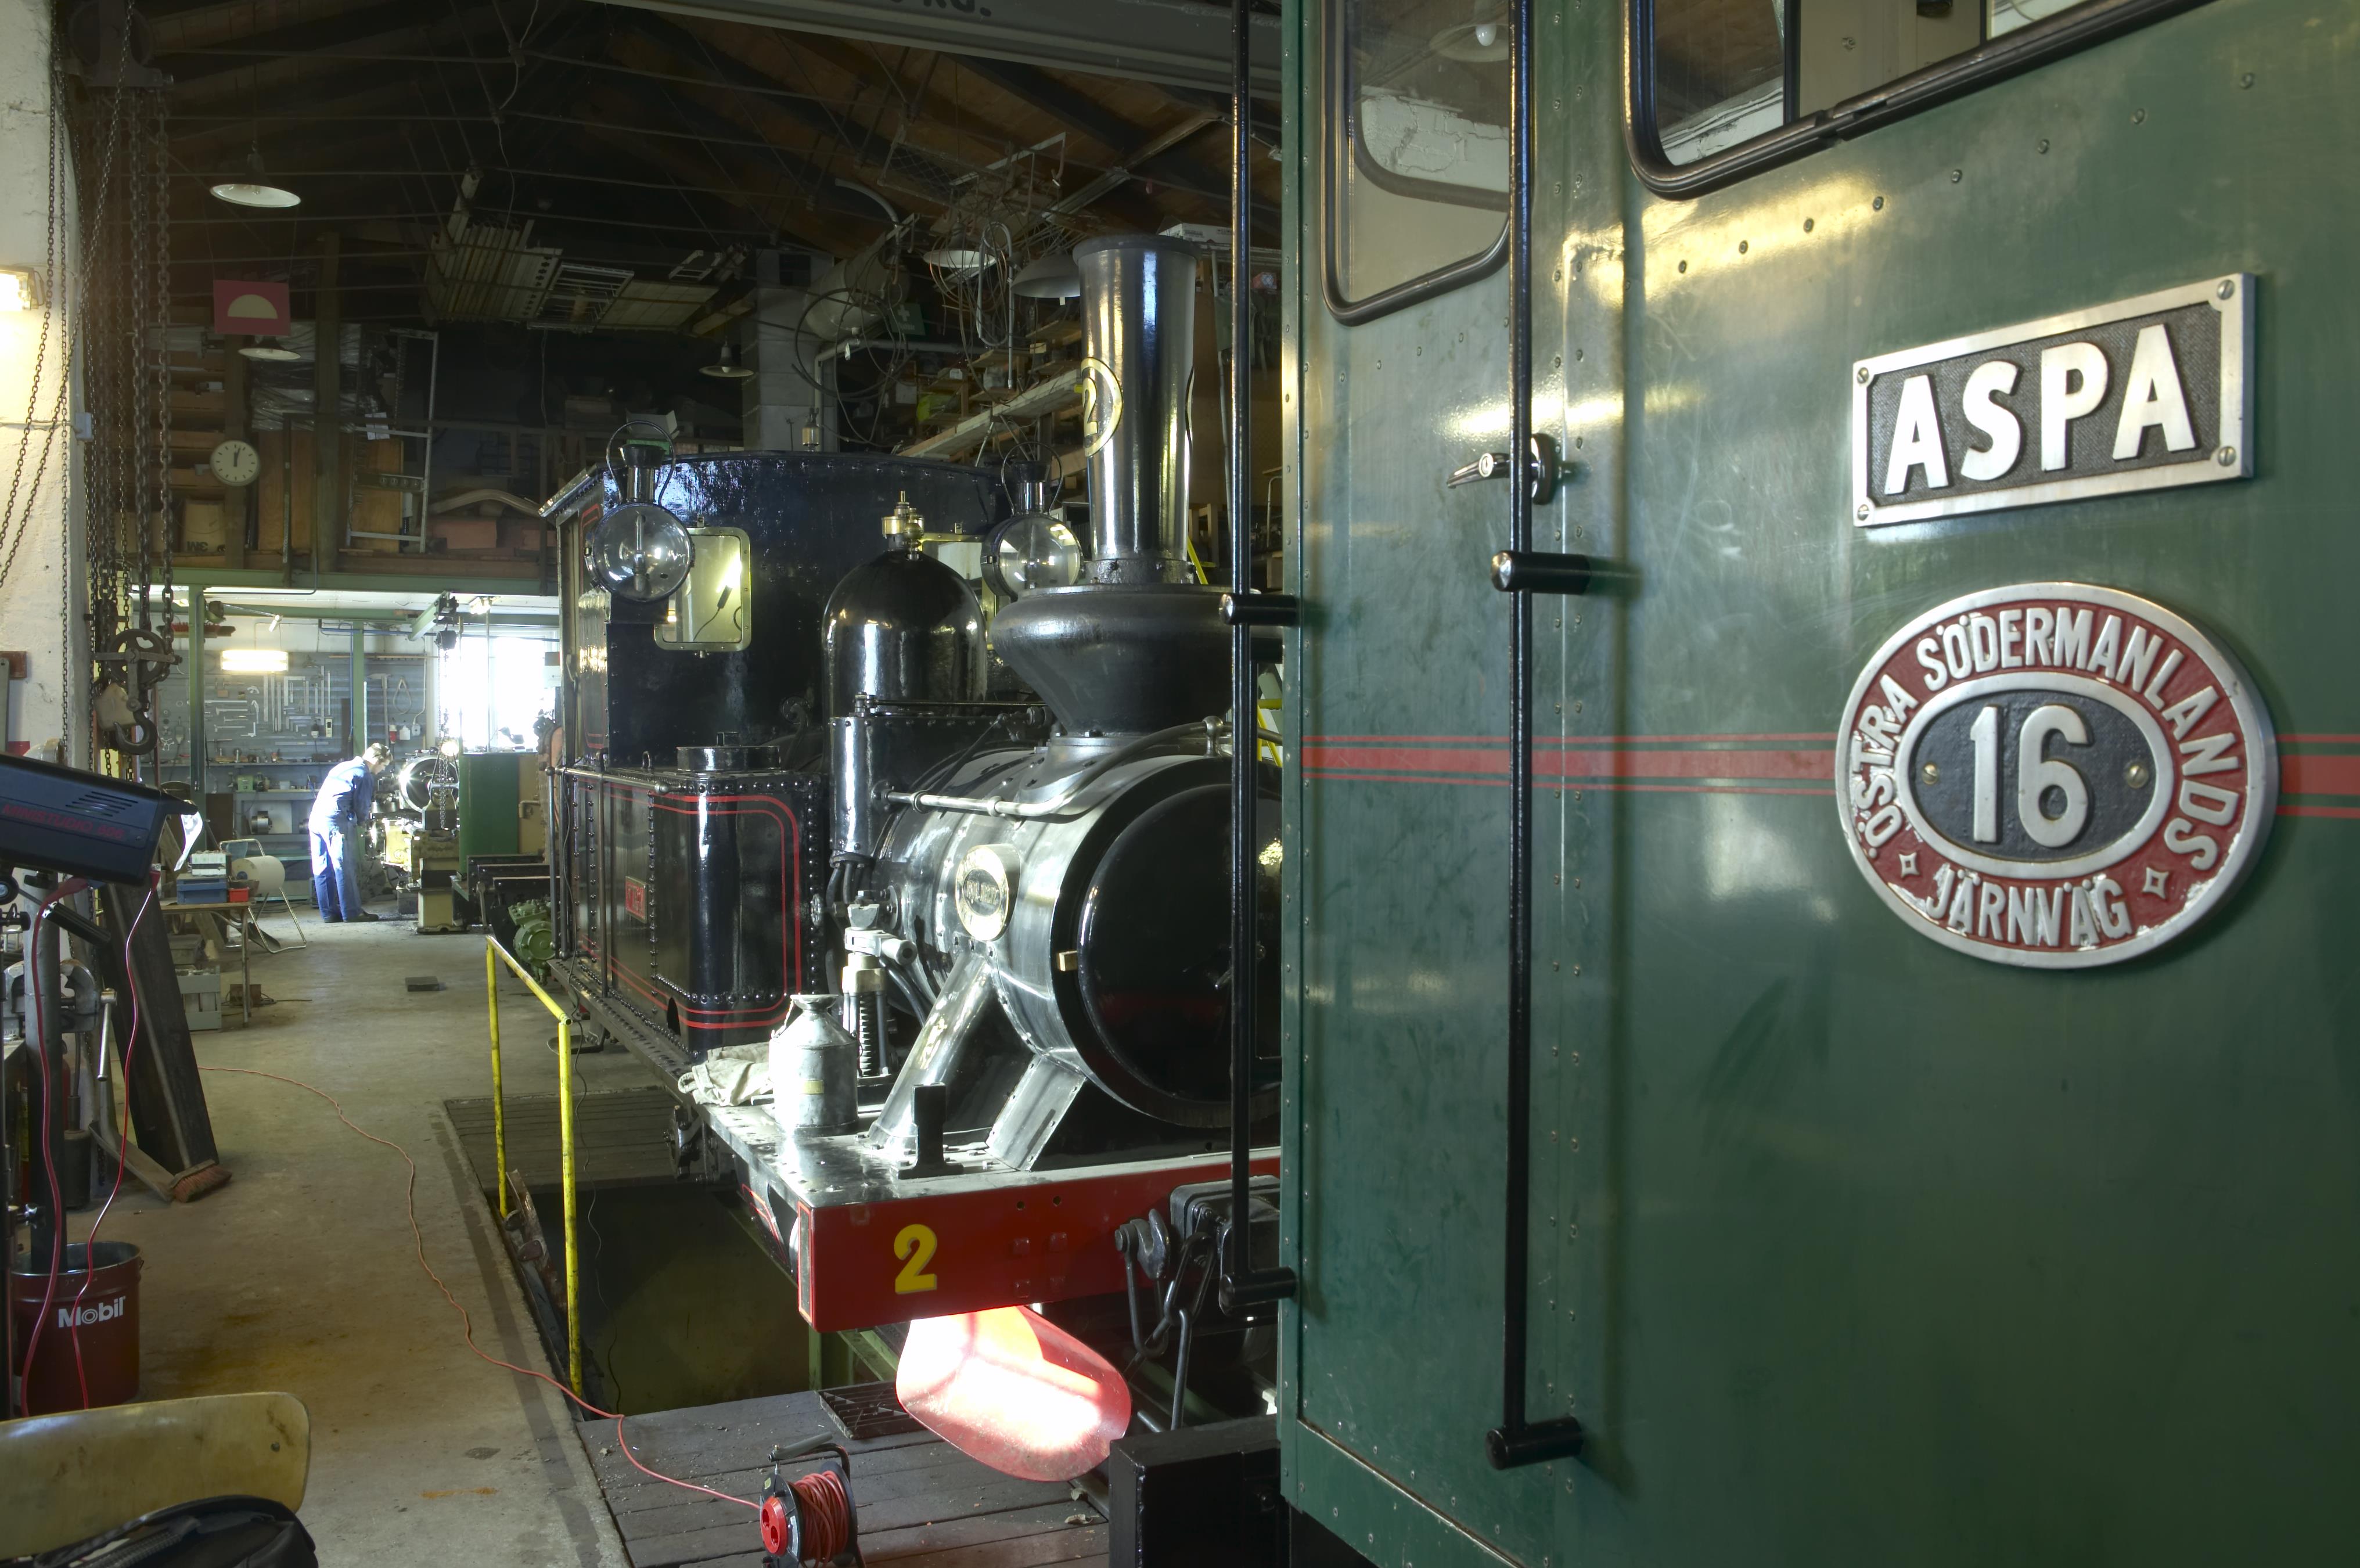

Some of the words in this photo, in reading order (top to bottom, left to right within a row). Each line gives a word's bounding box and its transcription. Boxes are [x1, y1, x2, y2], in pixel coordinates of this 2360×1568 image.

[1082, 377, 1098, 437] 2
[1885, 324, 2196, 494] ASPA
[1852, 674, 1919, 858] ÖSTRA
[1916, 607, 2239, 870] SÖDERMANLANDS
[1970, 705, 2089, 848] 16
[1926, 869, 2132, 947] JÄRNVÄG
[894, 1224, 938, 1294] 2
[58, 1296, 125, 1328] Mobil
